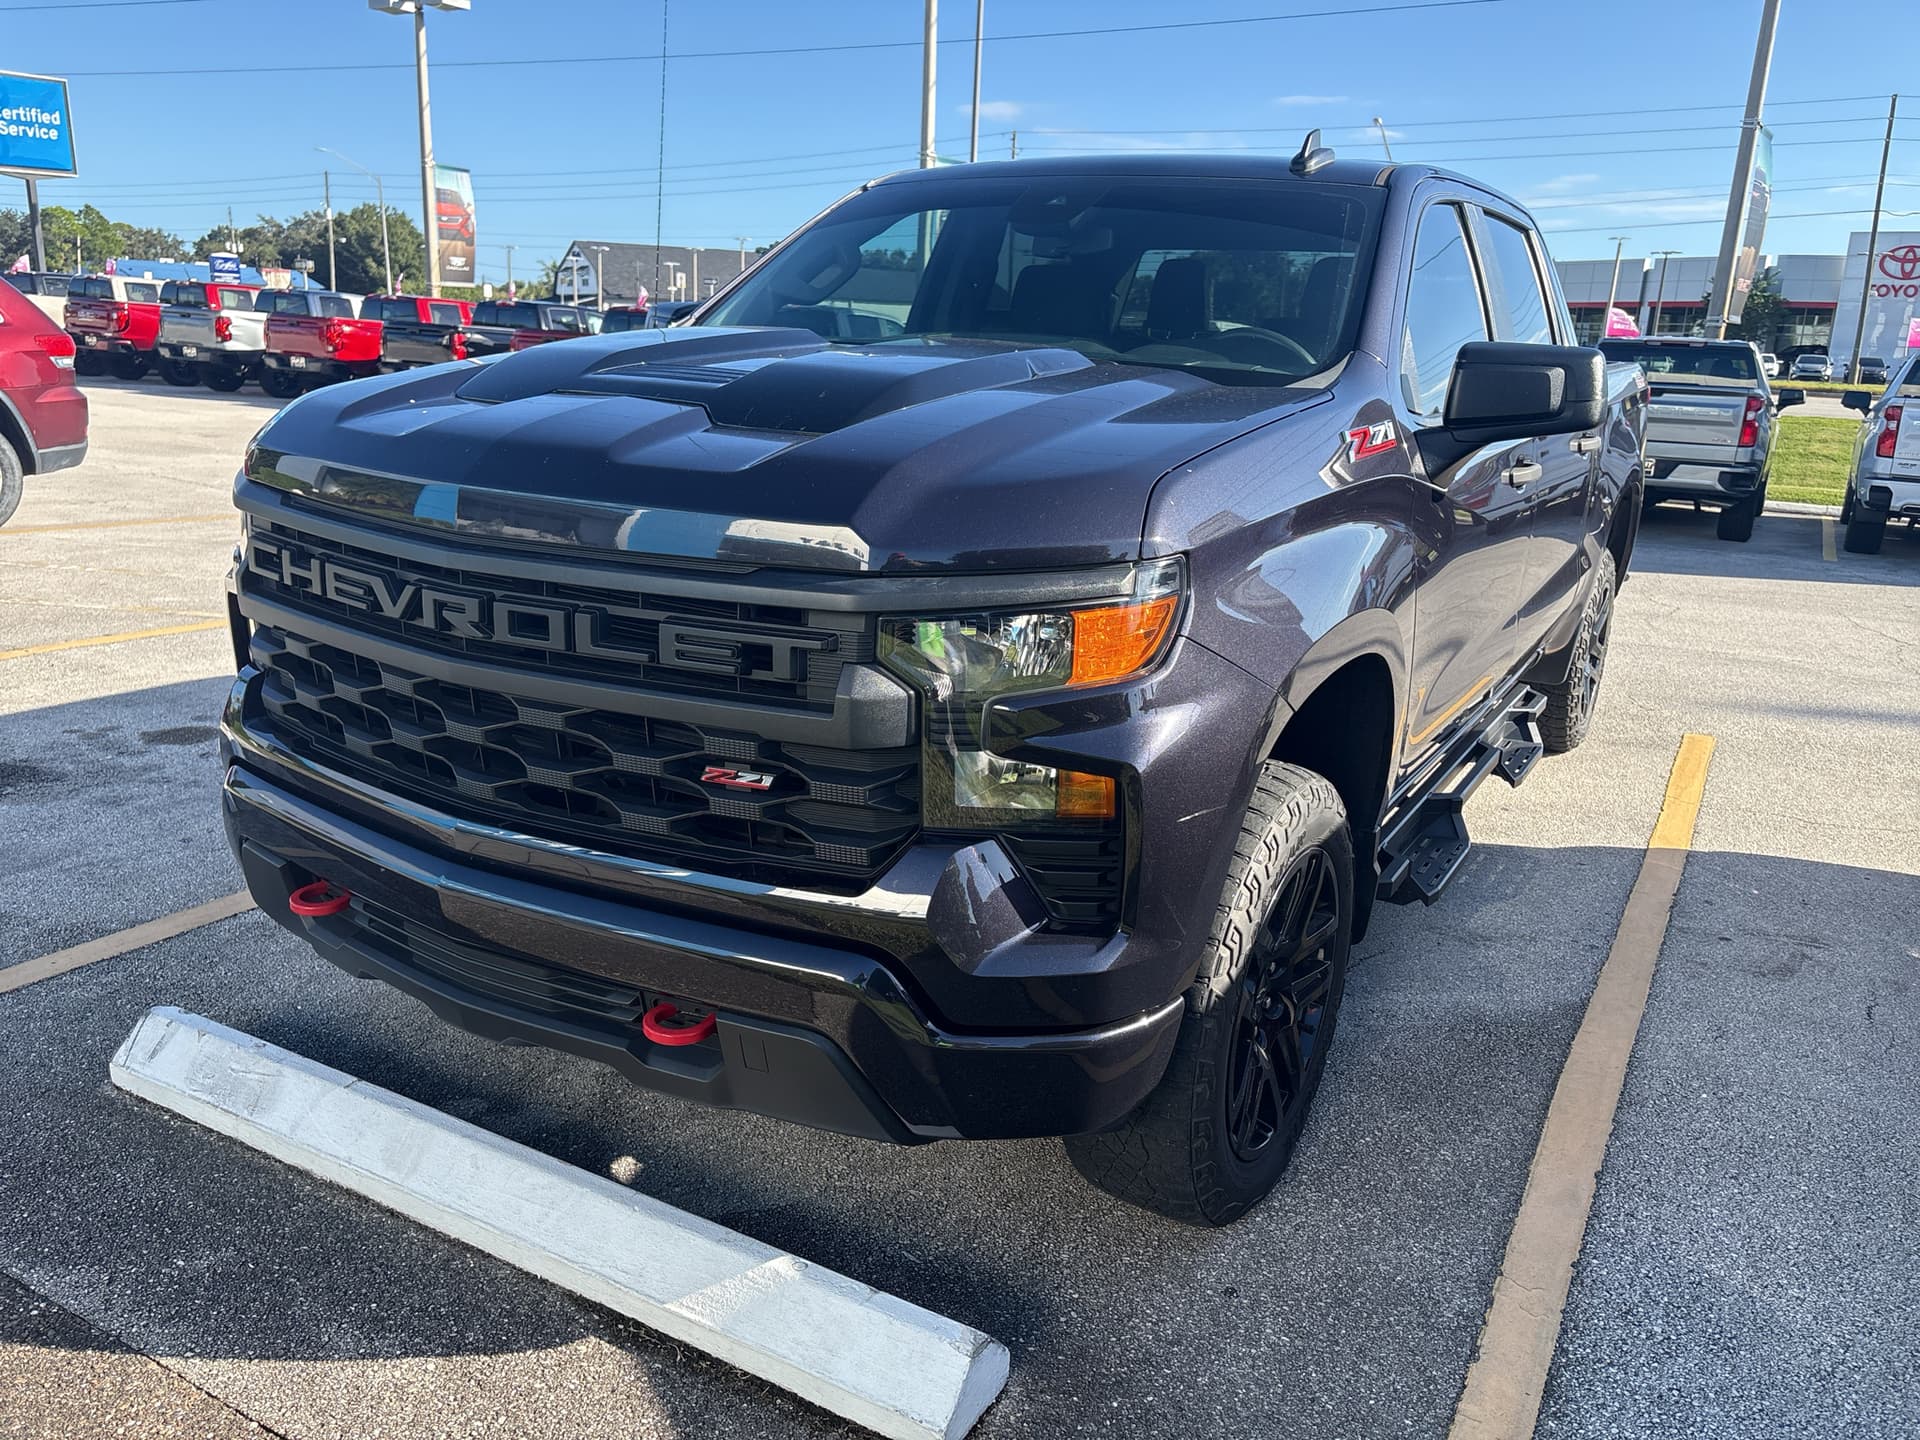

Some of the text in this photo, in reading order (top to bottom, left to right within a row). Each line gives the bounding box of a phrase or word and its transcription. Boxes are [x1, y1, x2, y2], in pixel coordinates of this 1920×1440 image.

[0, 120, 58, 140] Service
[1345, 420, 1398, 463] Z71
[248, 543, 834, 682] CHEVROLET
[701, 766, 775, 791] Z71
